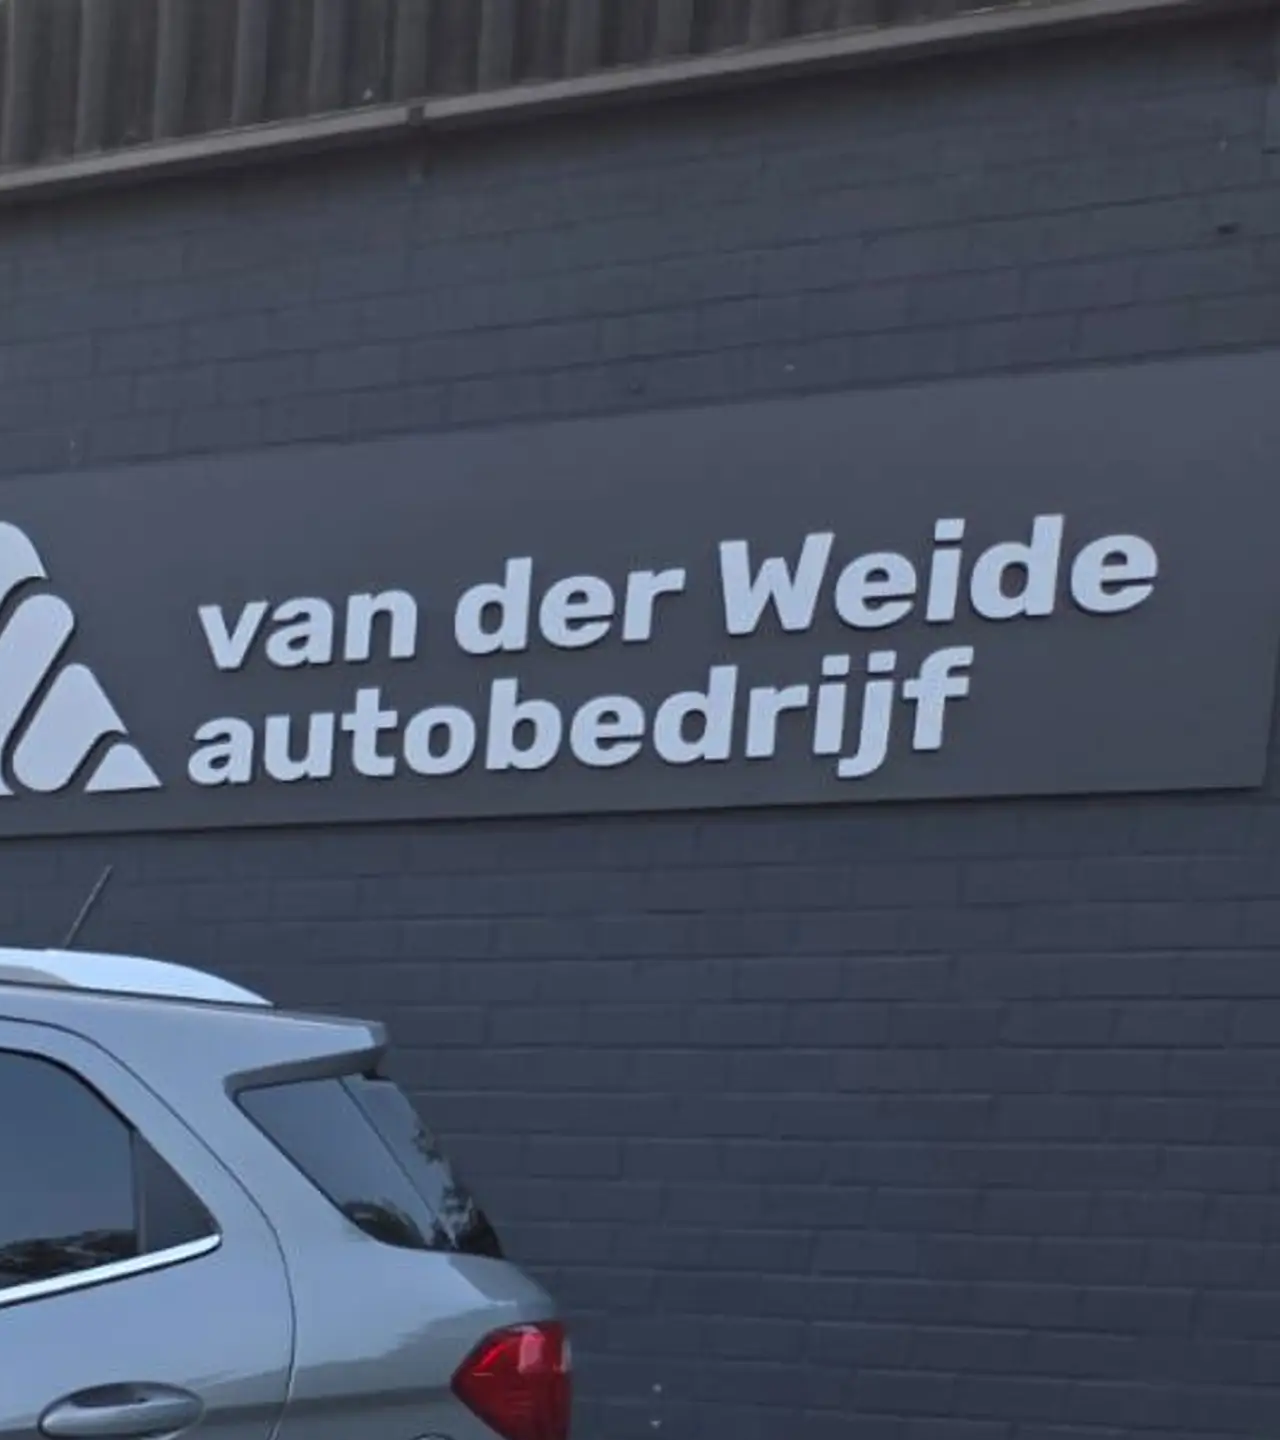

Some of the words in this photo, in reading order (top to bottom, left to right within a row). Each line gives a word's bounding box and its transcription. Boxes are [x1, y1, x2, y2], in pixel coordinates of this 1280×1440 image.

[197, 589, 419, 669] van
[453, 555, 688, 655] der
[718, 513, 1160, 636] Weide
[187, 645, 976, 785] autobedrijf
